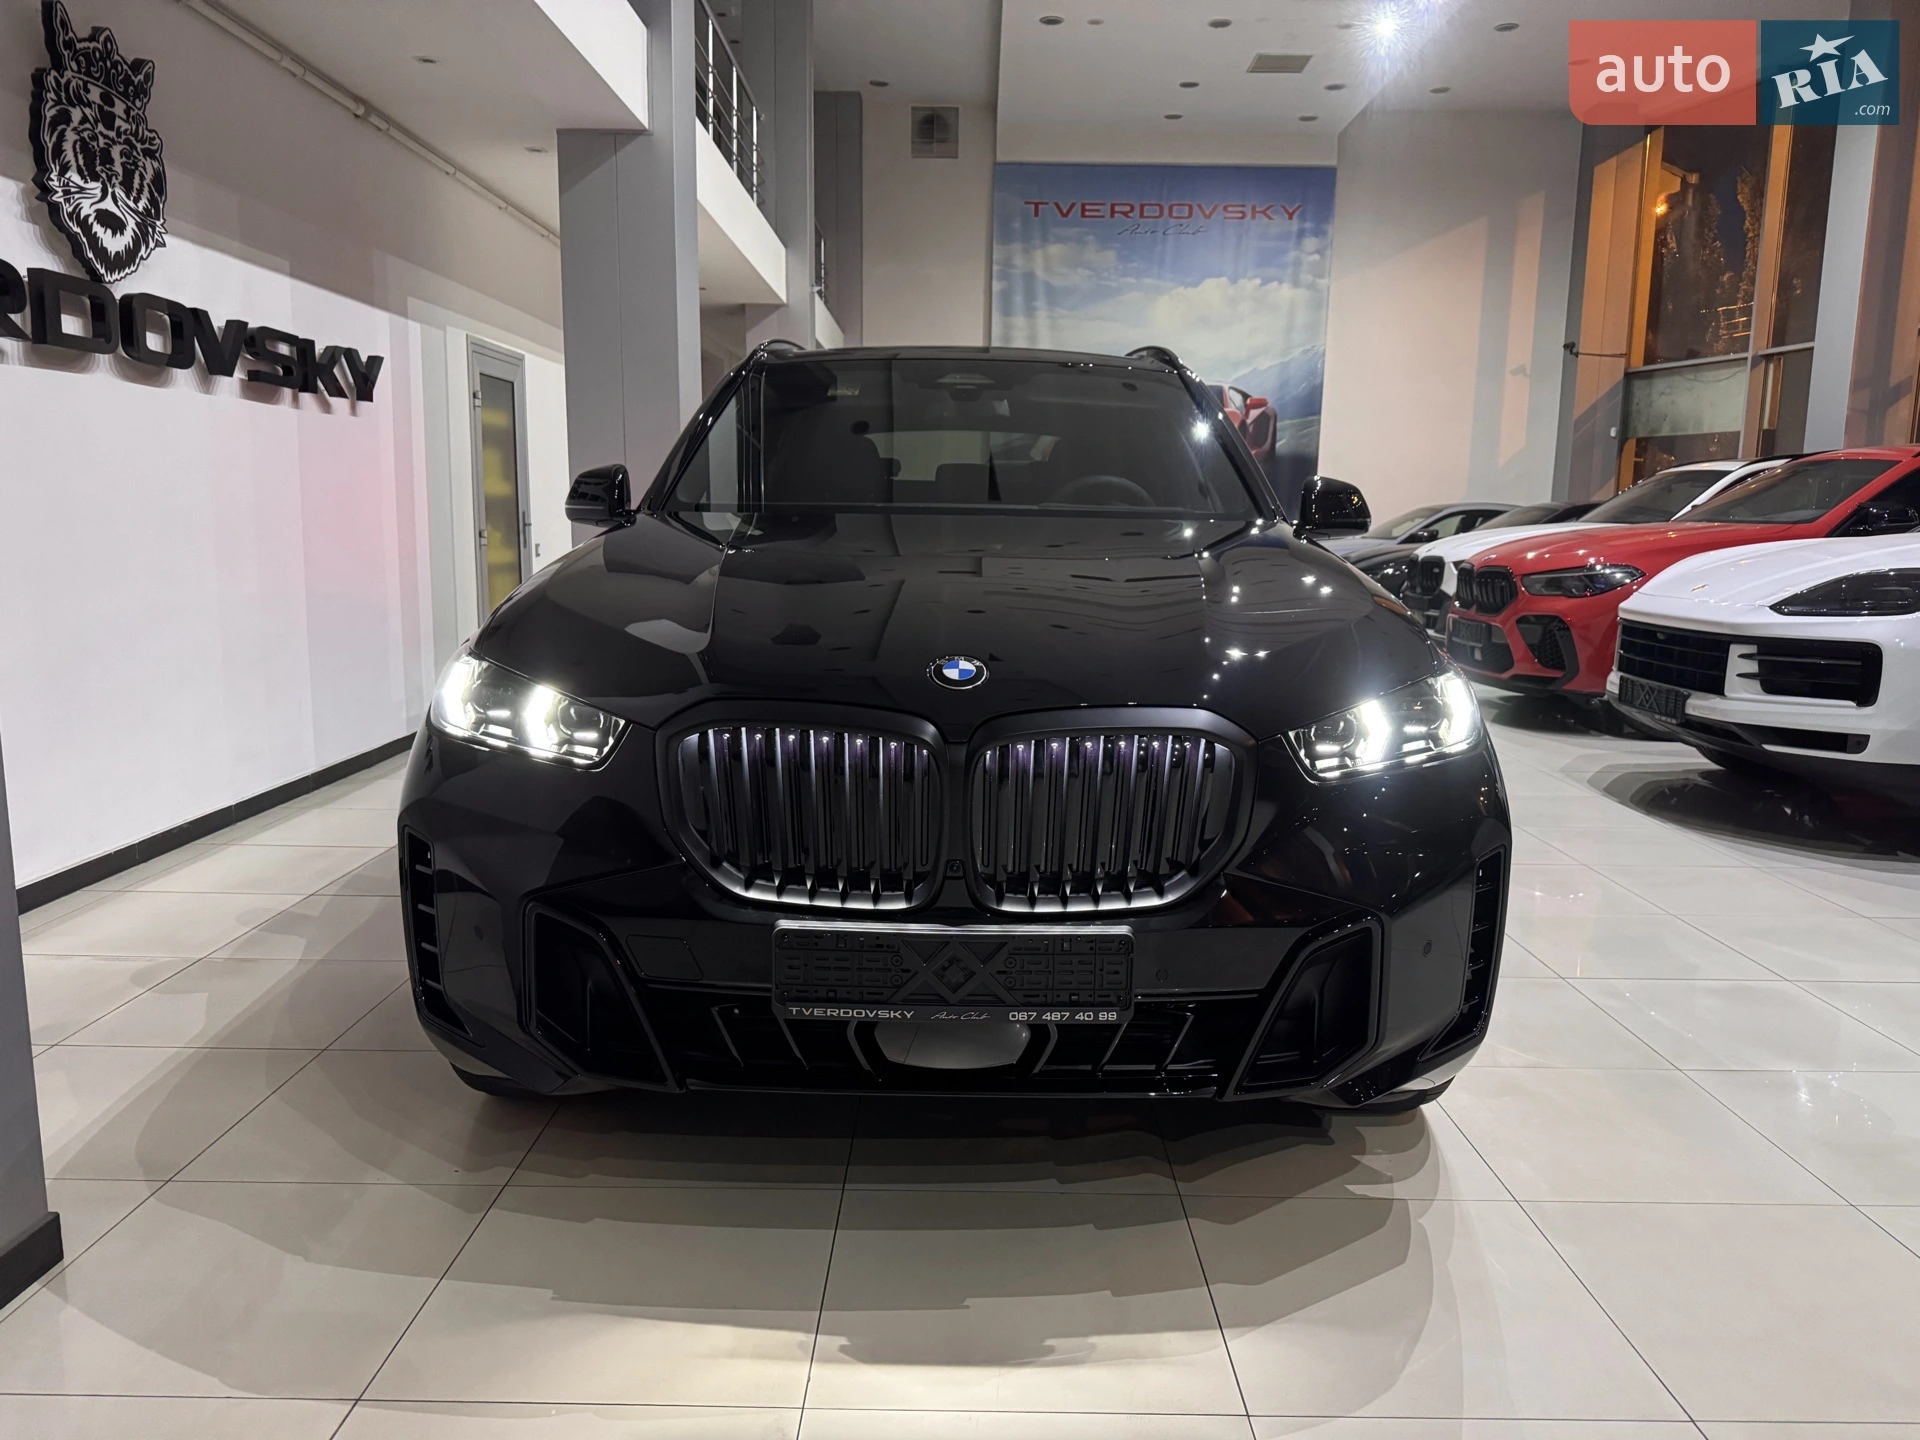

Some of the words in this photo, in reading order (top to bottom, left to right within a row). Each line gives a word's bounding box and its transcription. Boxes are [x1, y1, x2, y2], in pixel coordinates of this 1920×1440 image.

[1024, 201, 1304, 221] TVERDOVSKY
[788, 1007, 915, 1019] TVERDOVSKY
[1009, 1012, 1037, 1021] 067
[1041, 1012, 1070, 1021] 487
[1074, 1012, 1094, 1021] 40
